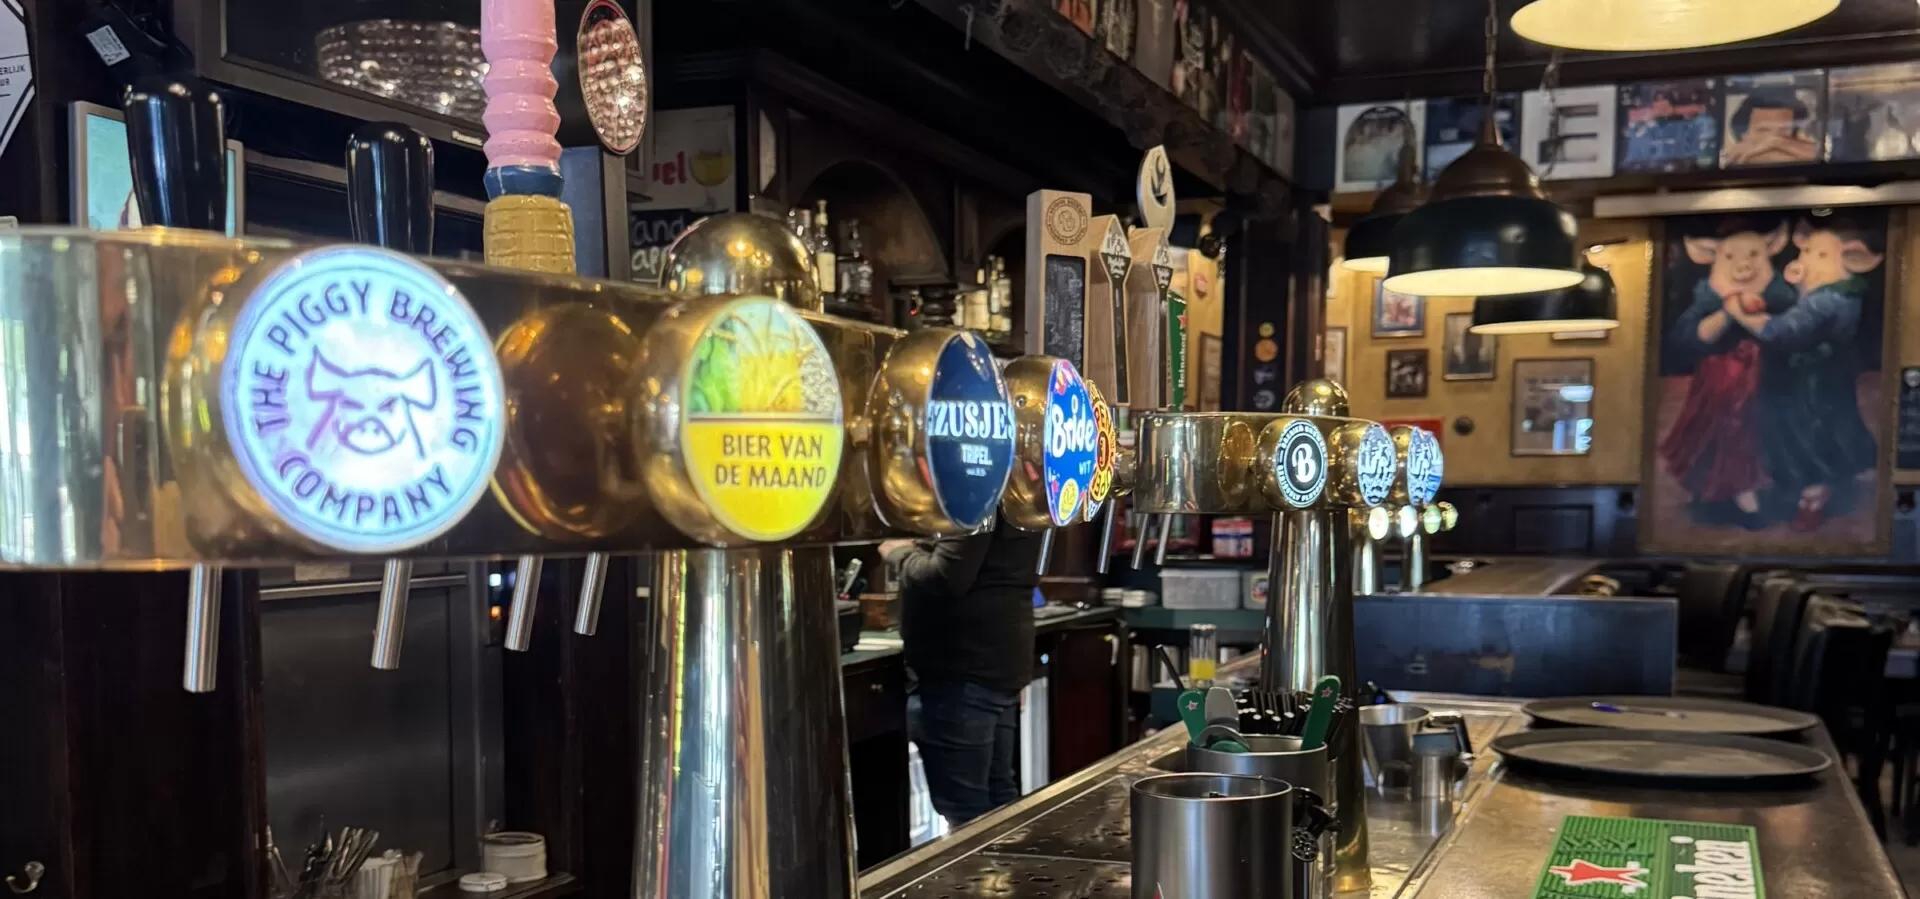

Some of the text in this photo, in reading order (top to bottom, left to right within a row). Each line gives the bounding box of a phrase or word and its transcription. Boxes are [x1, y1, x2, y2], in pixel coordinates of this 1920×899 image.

[253, 279, 482, 452] THE PIGGY BREWING
[722, 434, 823, 458] BIER VAN
[1051, 394, 1096, 458] Bride
[279, 456, 451, 525] COMPANY
[715, 464, 827, 488] DE MAAND
[1291, 443, 1317, 484] B
[1671, 840, 1757, 899] neken
